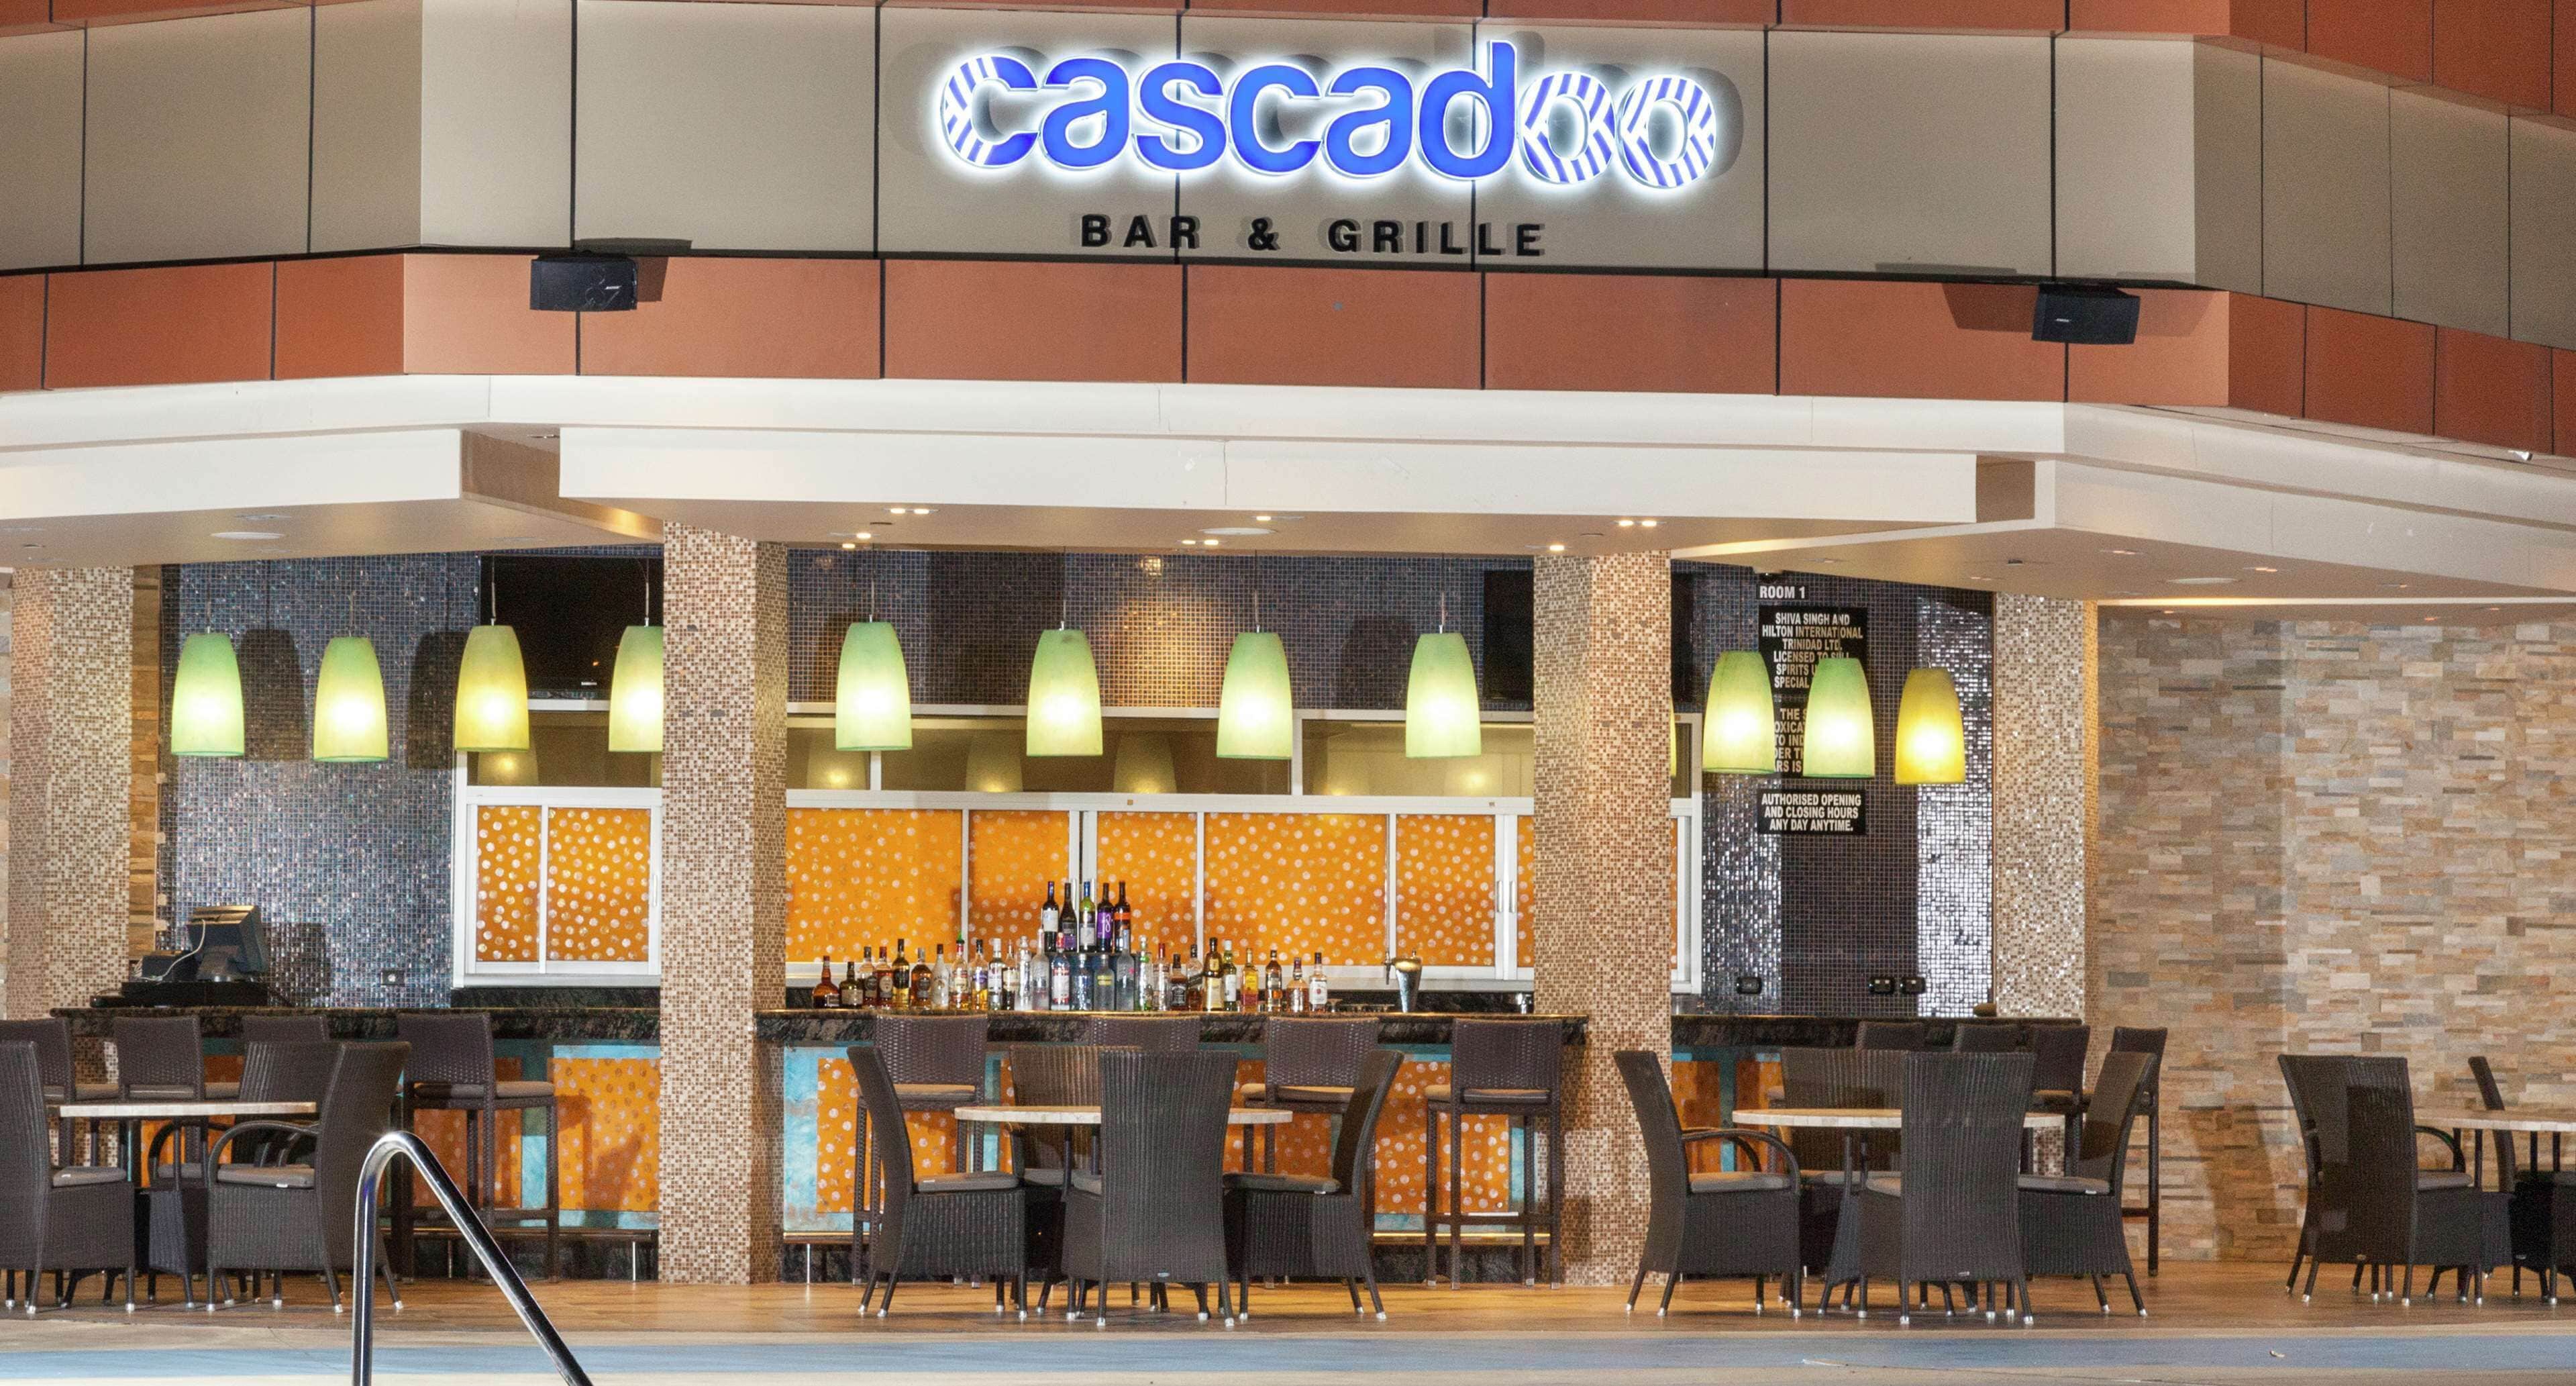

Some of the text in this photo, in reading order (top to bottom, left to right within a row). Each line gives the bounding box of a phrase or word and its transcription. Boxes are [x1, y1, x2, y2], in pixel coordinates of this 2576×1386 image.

[940, 40, 1716, 189] cascadoo
[1080, 214, 1541, 256] BAR & GRILLE
[1759, 585, 1806, 599] ROOM 1
[1775, 612, 1850, 626] SHIVA SINGH AND
[1761, 625, 1794, 638] HILTON
[1782, 638, 1843, 651] TRINIDAD LTD.
[1773, 650, 1815, 662] LICENSED
[1775, 663, 1809, 676] SPIRITS
[1774, 676, 1809, 689] SPECIAL
[1780, 707, 1800, 720] THE
[1792, 760, 1802, 773] IS
[1761, 793, 1861, 806] AUTHORISED OPENING
[1764, 806, 1859, 819] AND CLOSING HOURS
[1769, 819, 1854, 832] ANY DAY ANYTIME.
